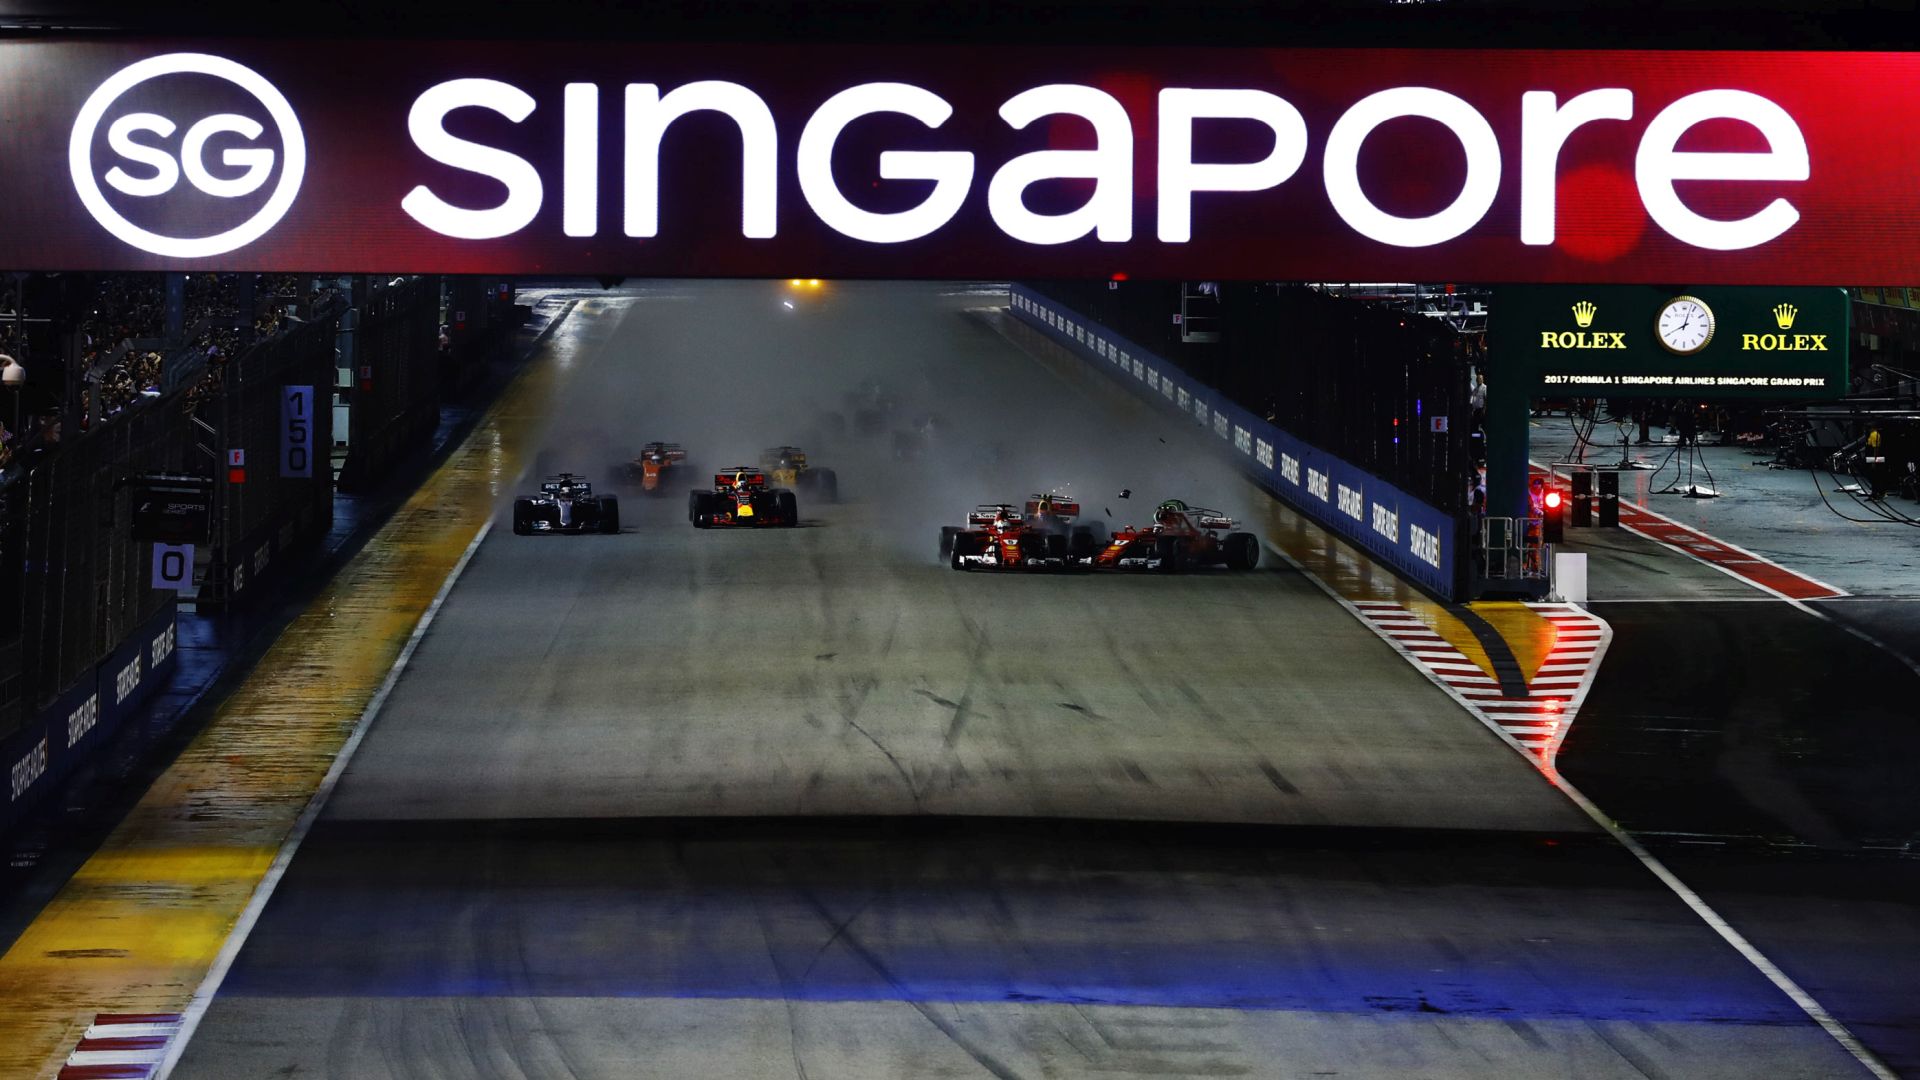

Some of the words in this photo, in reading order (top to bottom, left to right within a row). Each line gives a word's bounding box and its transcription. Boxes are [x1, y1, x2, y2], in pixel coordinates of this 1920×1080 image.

[105, 113, 274, 198] SG
[1541, 331, 1627, 349] ROLEX
[1742, 333, 1829, 351] ROLEX
[1544, 375, 1568, 384] 2017
[1570, 375, 1612, 384] FORMULA
[1621, 376, 1674, 385] SINGAPORE
[1674, 376, 1716, 385] AIRLINES
[1717, 377, 1769, 385] SINGAPORE
[1770, 377, 1803, 386] GRAND
[1804, 378, 1825, 386] PRIX
